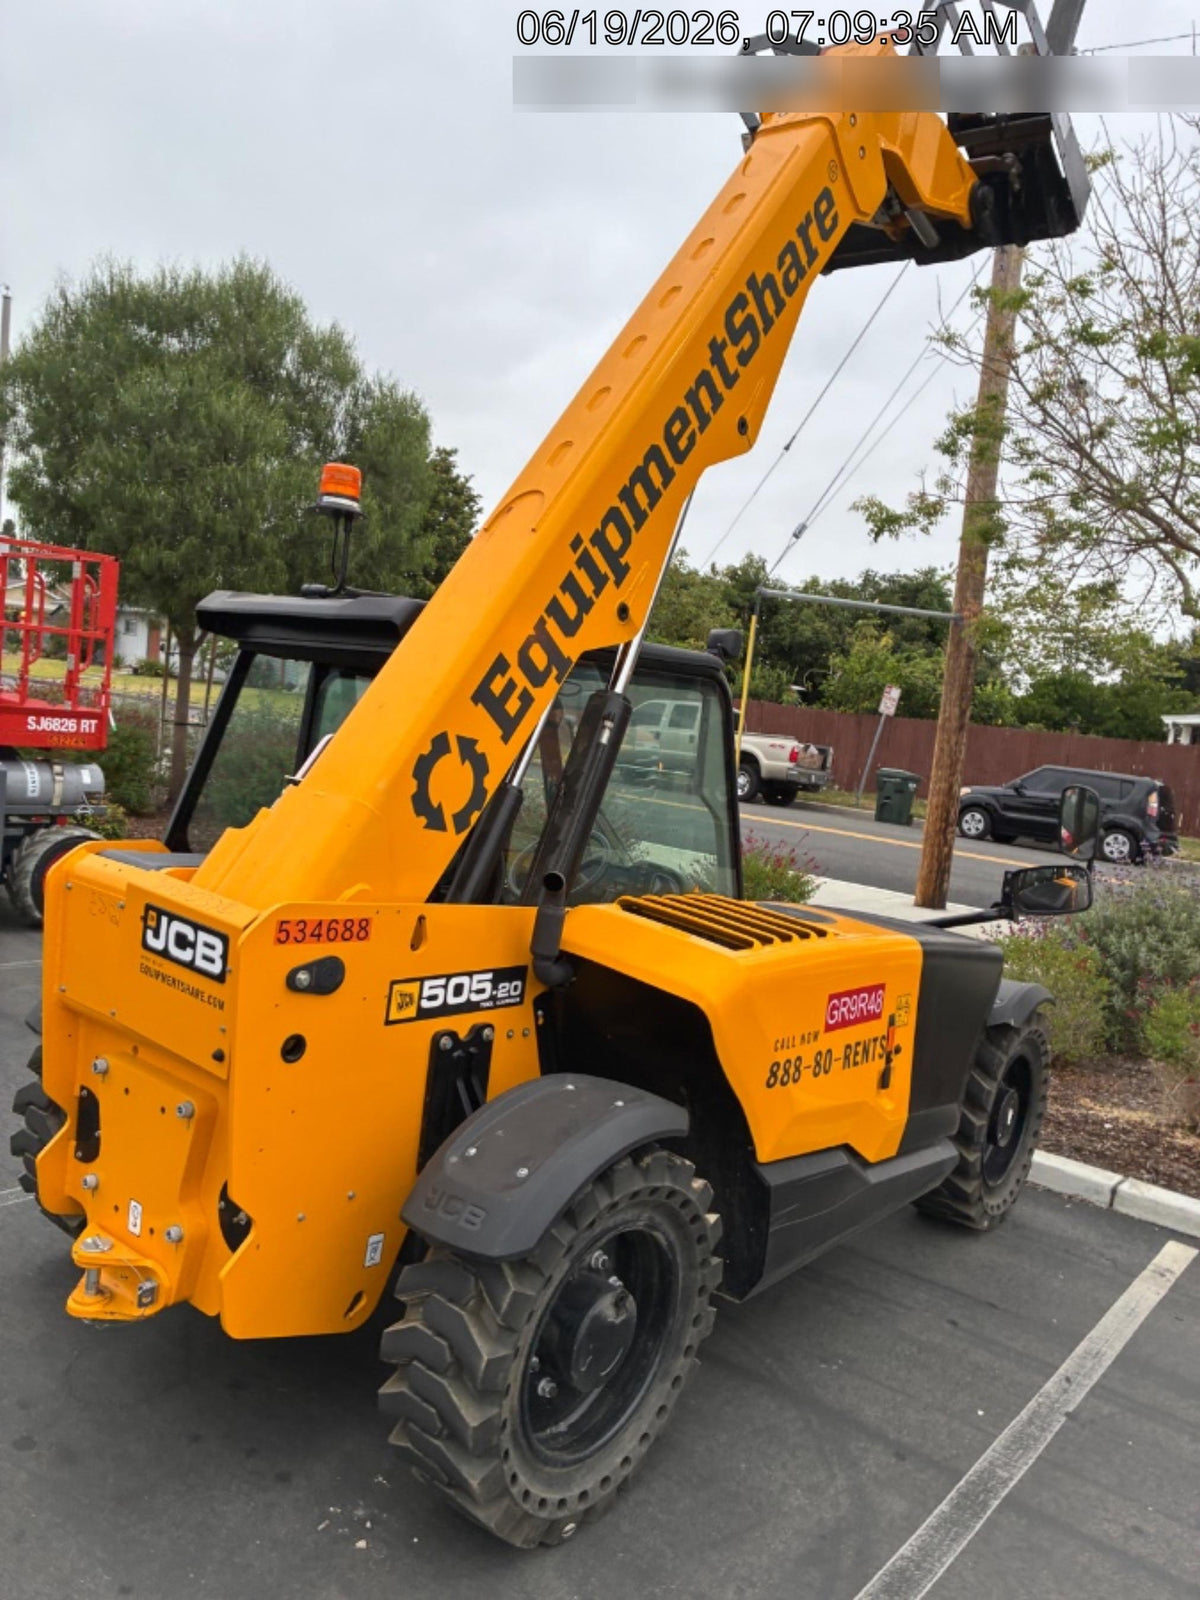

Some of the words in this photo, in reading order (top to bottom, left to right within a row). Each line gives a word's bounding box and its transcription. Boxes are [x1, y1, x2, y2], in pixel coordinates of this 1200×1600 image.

[471, 186, 839, 743] EquipmentShare
[27, 716, 77, 732] SJ6826
[80, 719, 98, 733] RT
[145, 915, 224, 977] JCB
[276, 918, 370, 944] 534688
[765, 1034, 888, 1089] 888-80-RENTS
[774, 1035, 797, 1053] CALL
[799, 1030, 821, 1046] NOW
[422, 1186, 488, 1231] JCB
